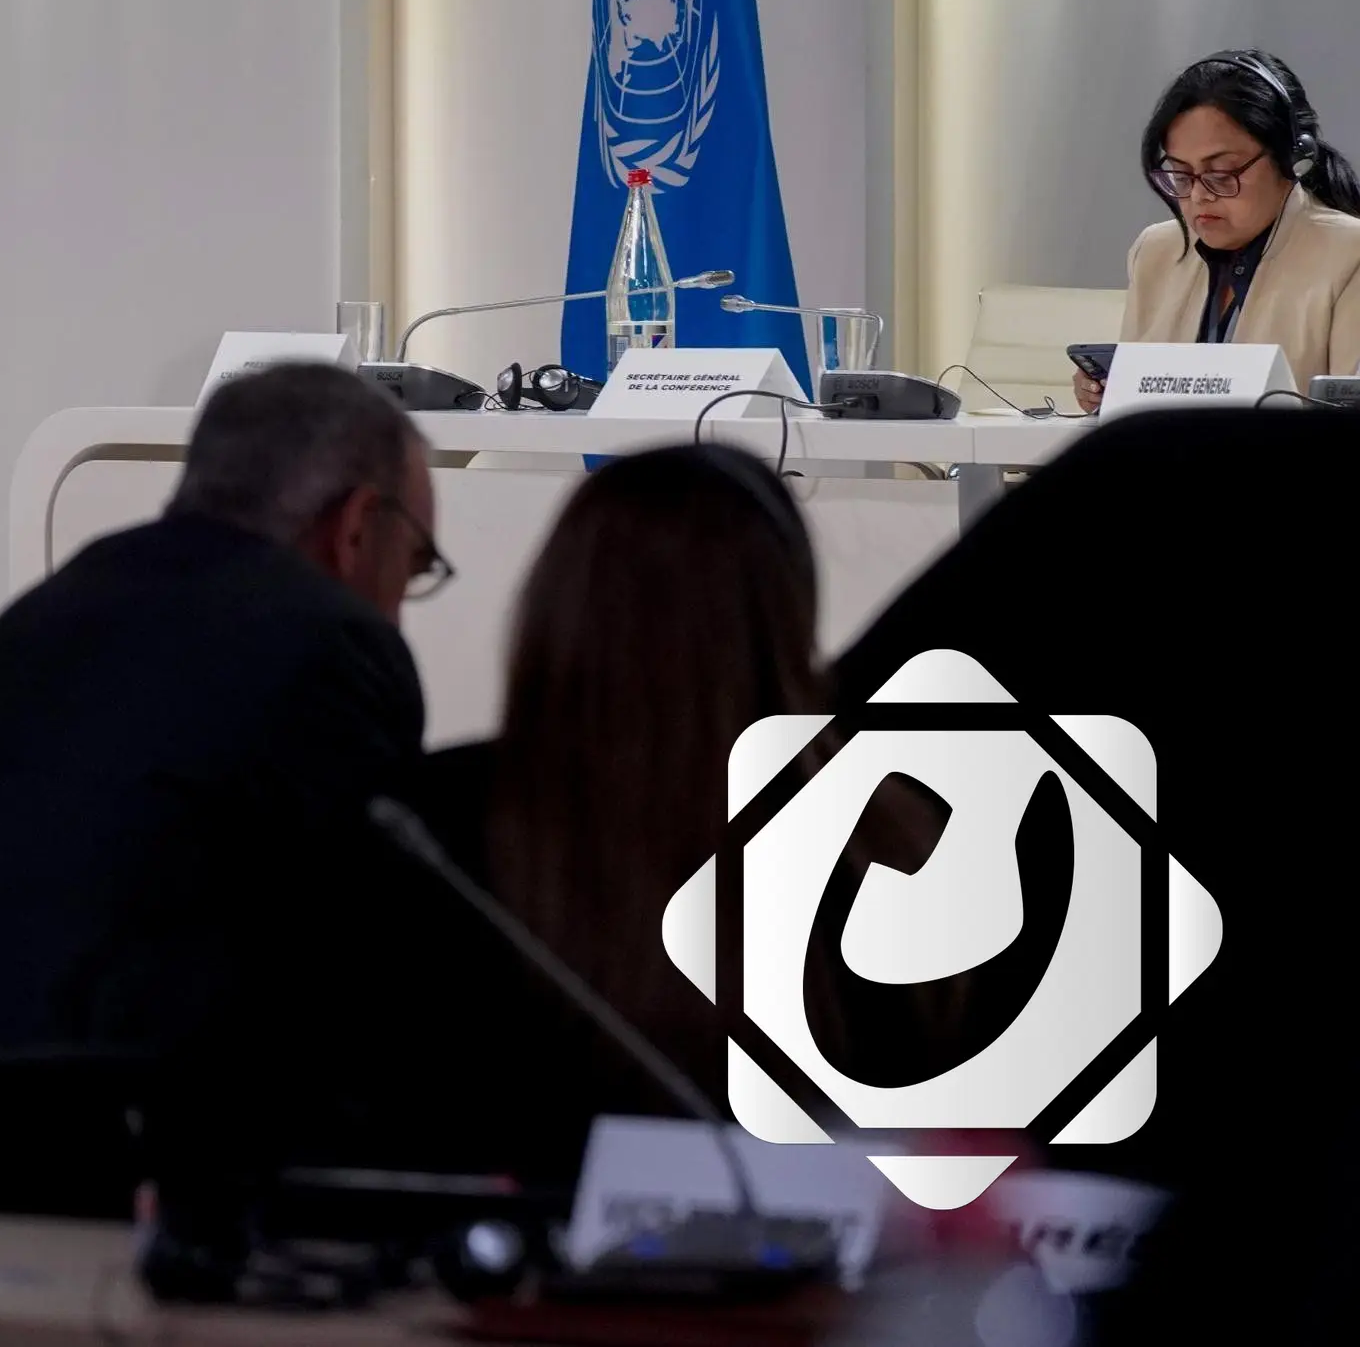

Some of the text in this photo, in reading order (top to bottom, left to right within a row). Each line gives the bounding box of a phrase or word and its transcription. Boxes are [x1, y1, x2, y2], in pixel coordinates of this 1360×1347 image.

[626, 373, 742, 382] SECRÉTAIRE GÉNÉRAL
[628, 383, 643, 391] DE
[645, 383, 659, 391] LA
[1138, 373, 1232, 395] SECRÉTAIRE GÉNÉRAL
